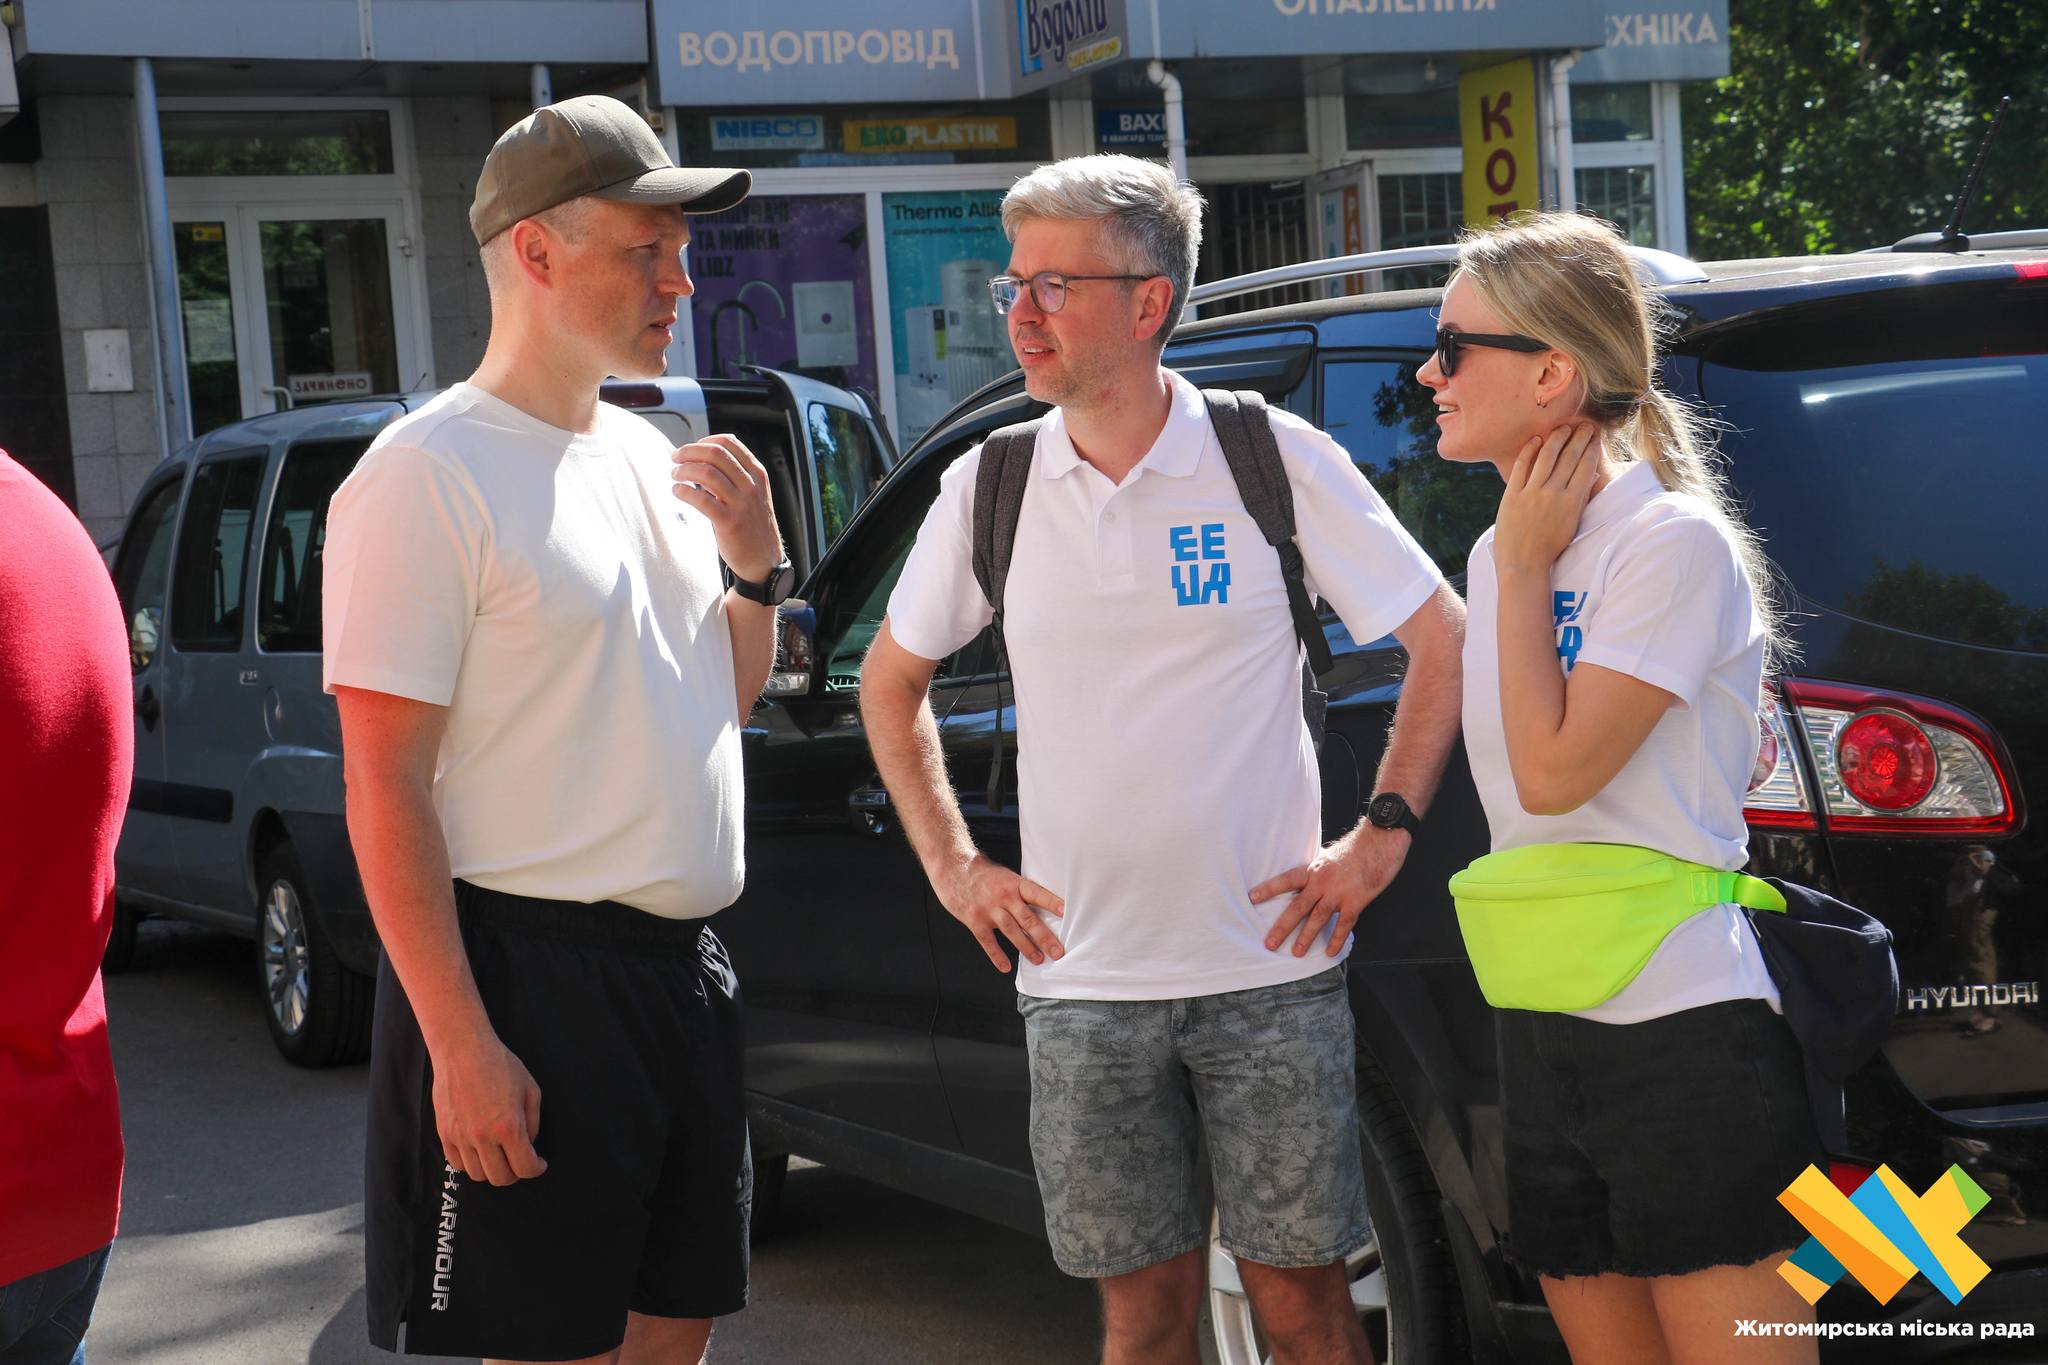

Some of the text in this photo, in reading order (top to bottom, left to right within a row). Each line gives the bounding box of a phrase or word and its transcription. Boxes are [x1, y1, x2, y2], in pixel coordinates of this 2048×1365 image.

[1604, 12, 1719, 46] ХНІКА
[678, 29, 959, 73] ВОДОПРОВІД
[717, 119, 816, 139] NIBCO
[861, 124, 999, 147] EKOPLASTIK
[893, 205, 964, 220] Thermo
[697, 256, 736, 278] LIDZ
[1169, 523, 1226, 562] EE
[1170, 562, 1232, 606] UA
[1907, 981, 2039, 1010] HYUNDAI
[431, 1191, 457, 1311] ARMOUR
